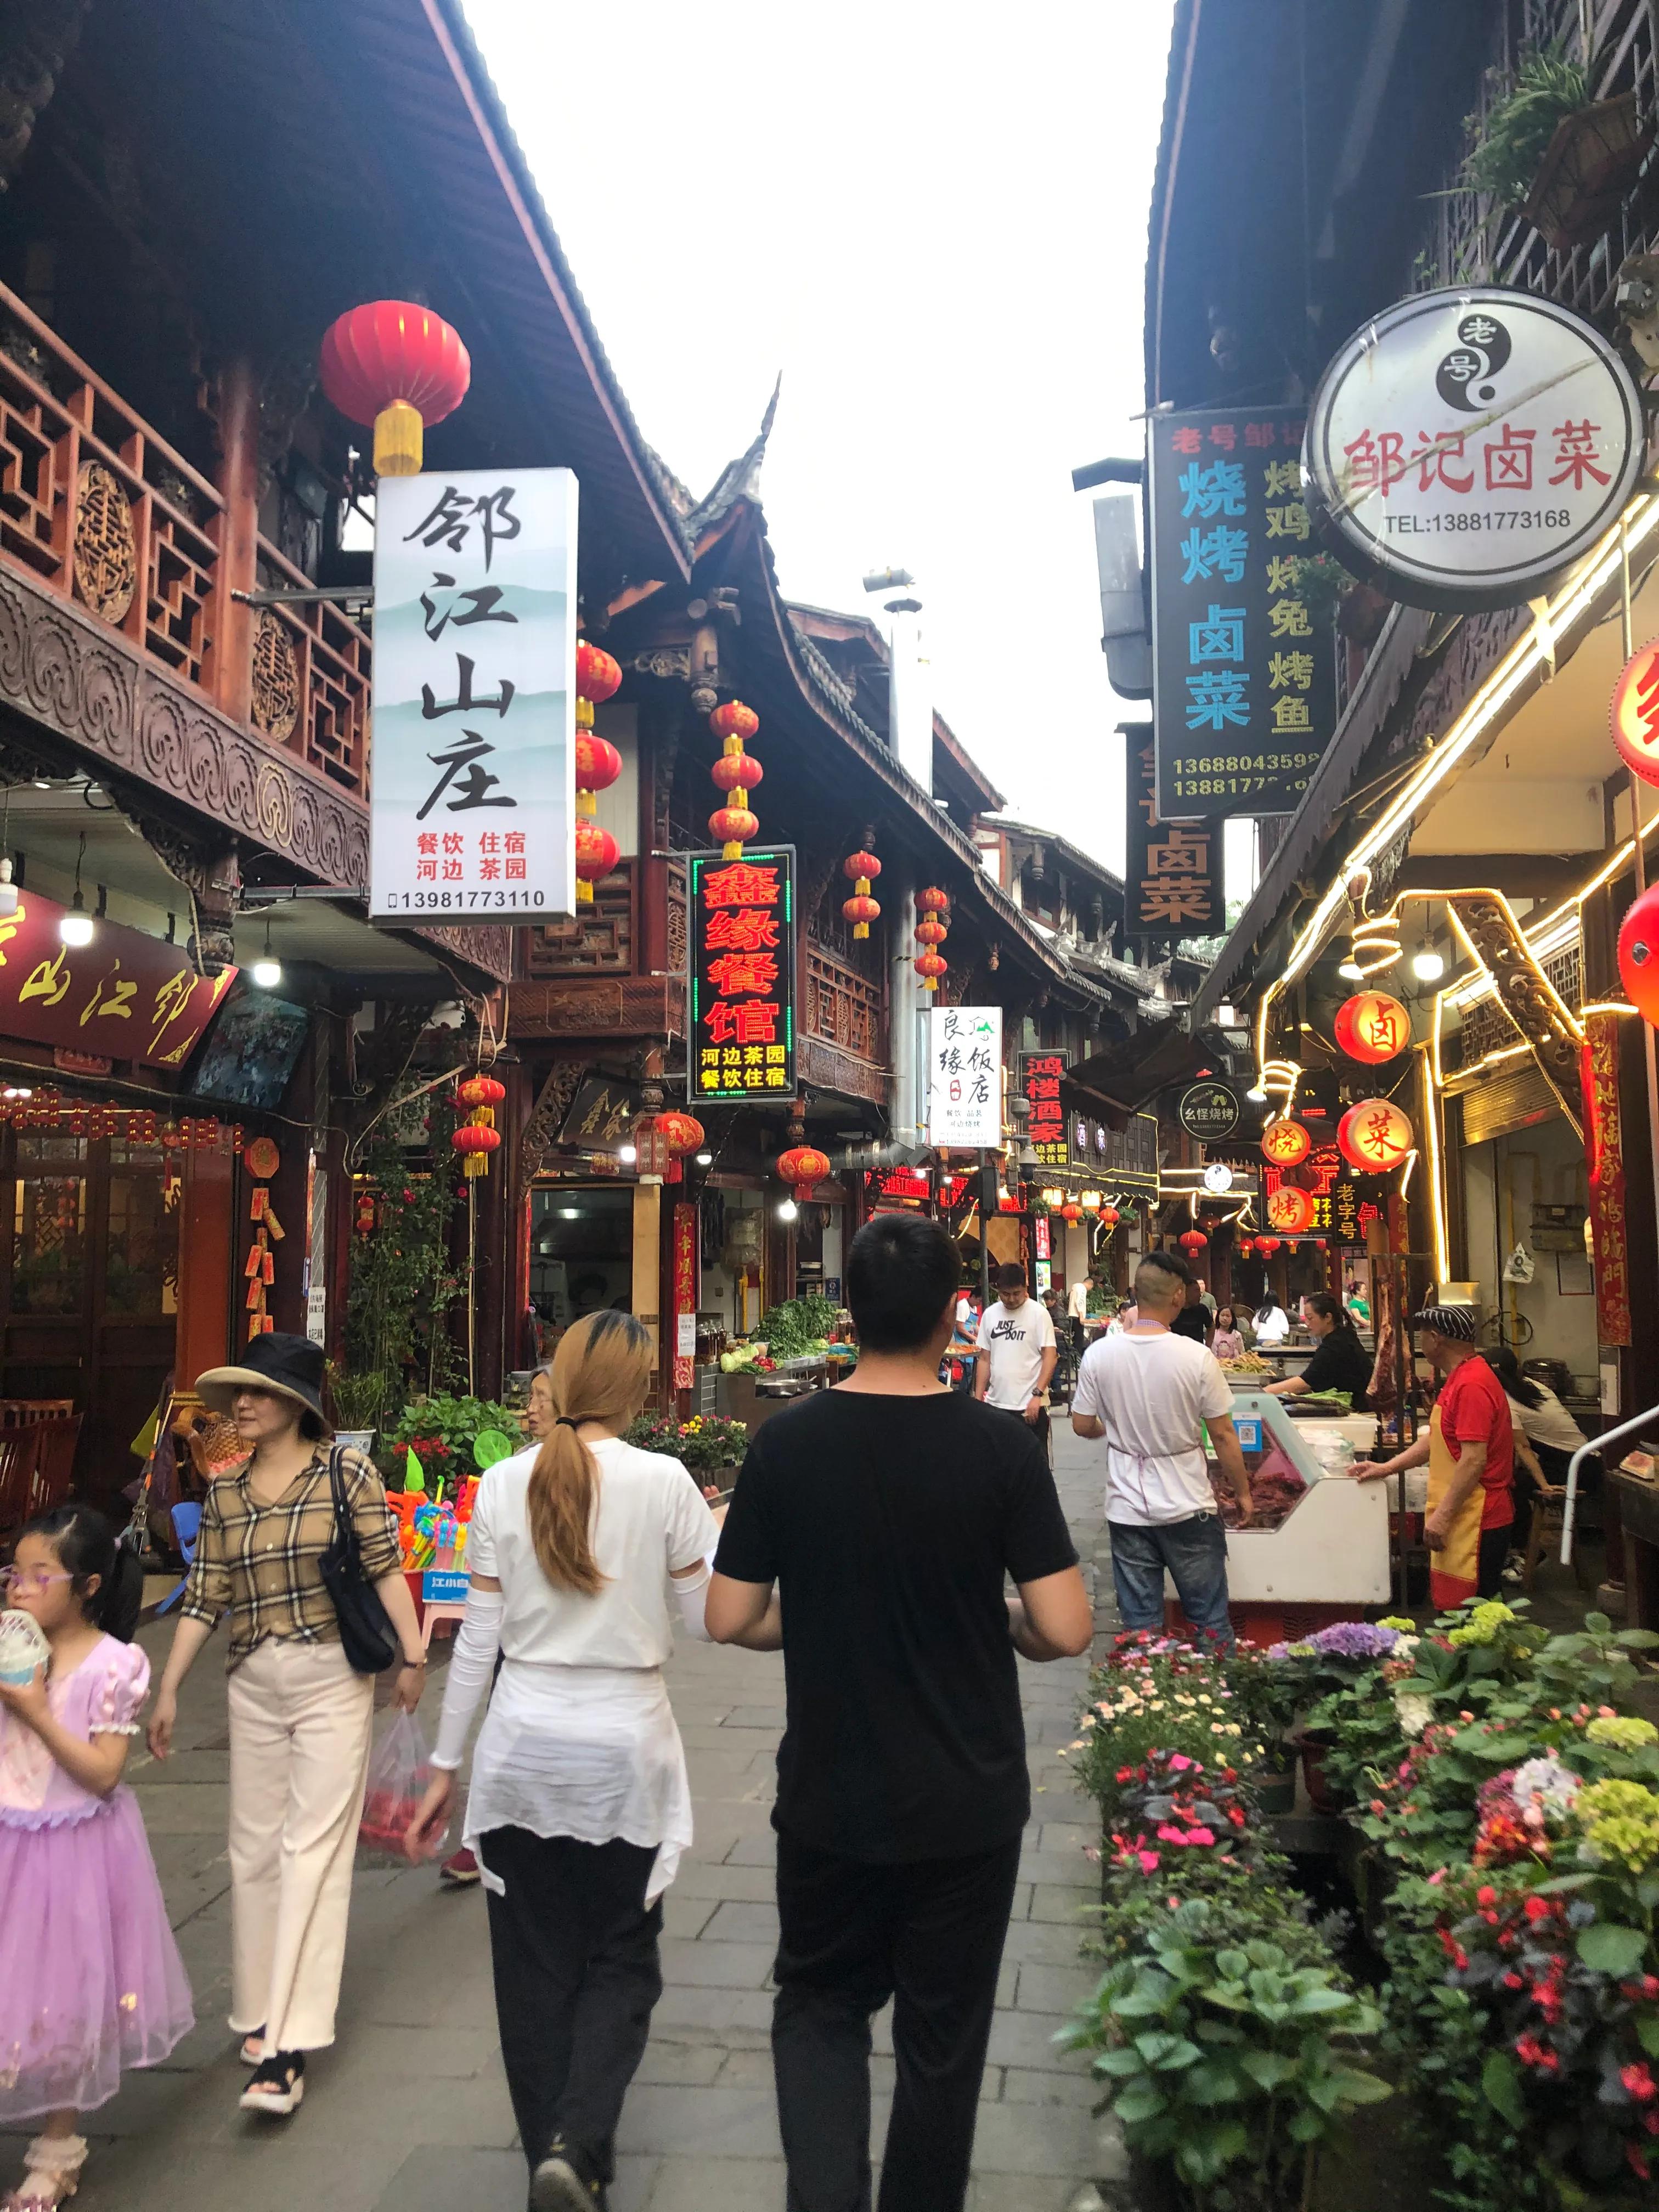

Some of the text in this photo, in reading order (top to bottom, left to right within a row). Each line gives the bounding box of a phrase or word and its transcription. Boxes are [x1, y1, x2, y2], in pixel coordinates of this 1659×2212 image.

[1344, 418, 1612, 497] 邹记卤菜
[1385, 508, 1571, 534] TEL:13881773168
[402, 486, 522, 821] 邻江山庄
[417, 830, 527, 855] 餐饮 住宿
[416, 857, 527, 882] 河边 茶园
[402, 890, 545, 909] 13981773110
[703, 863, 781, 1043] 鑫缘餐馆
[702, 1045, 786, 1066] 河边茶园
[701, 1067, 786, 1089] 餐饮住宿
[1363, 1000, 1405, 1159] 卤 菜
[1026, 1056, 1065, 1143] 鸿楼酒家
[1268, 1128, 1301, 1155] 烧
[1272, 1193, 1300, 1224] 烤
[1336, 1183, 1357, 1239] 老字号
[995, 1320, 1015, 1330] JUST
[432, 1576, 469, 1588] 江小白
